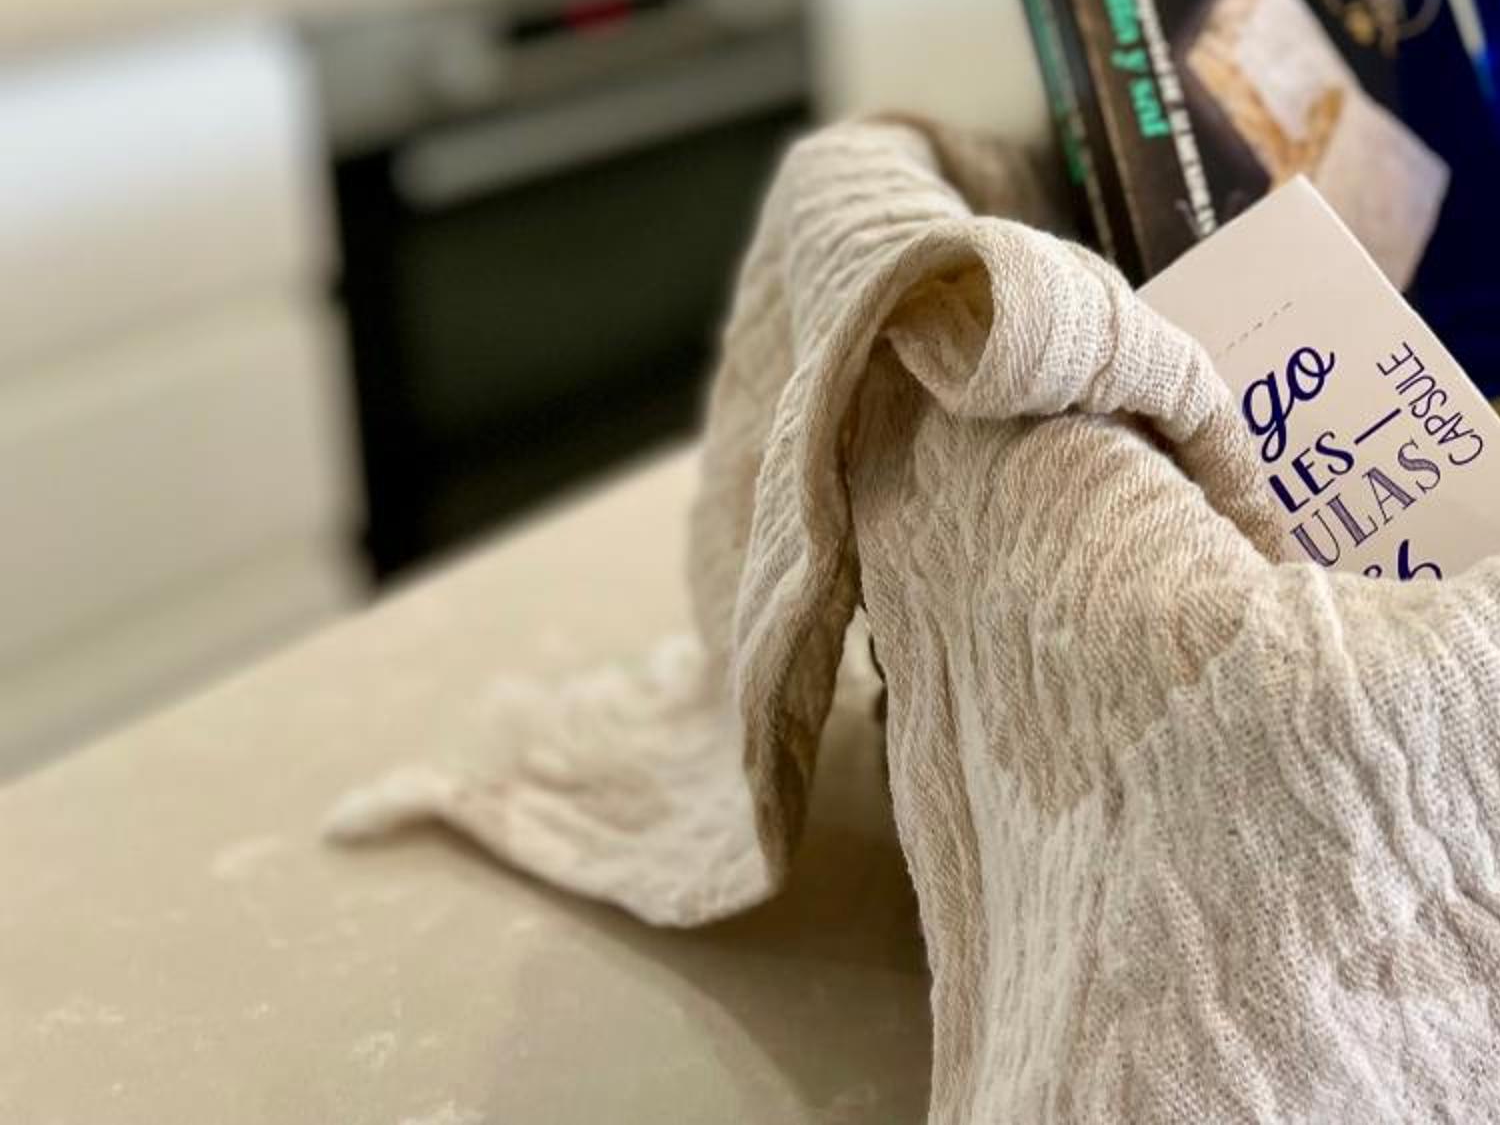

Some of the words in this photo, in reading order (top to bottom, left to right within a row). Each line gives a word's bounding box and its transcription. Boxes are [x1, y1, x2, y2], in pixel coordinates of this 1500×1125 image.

[1241, 346, 1336, 464] go
[1375, 341, 1485, 466] CAPSULE
[1289, 439, 1442, 568] ULAS
